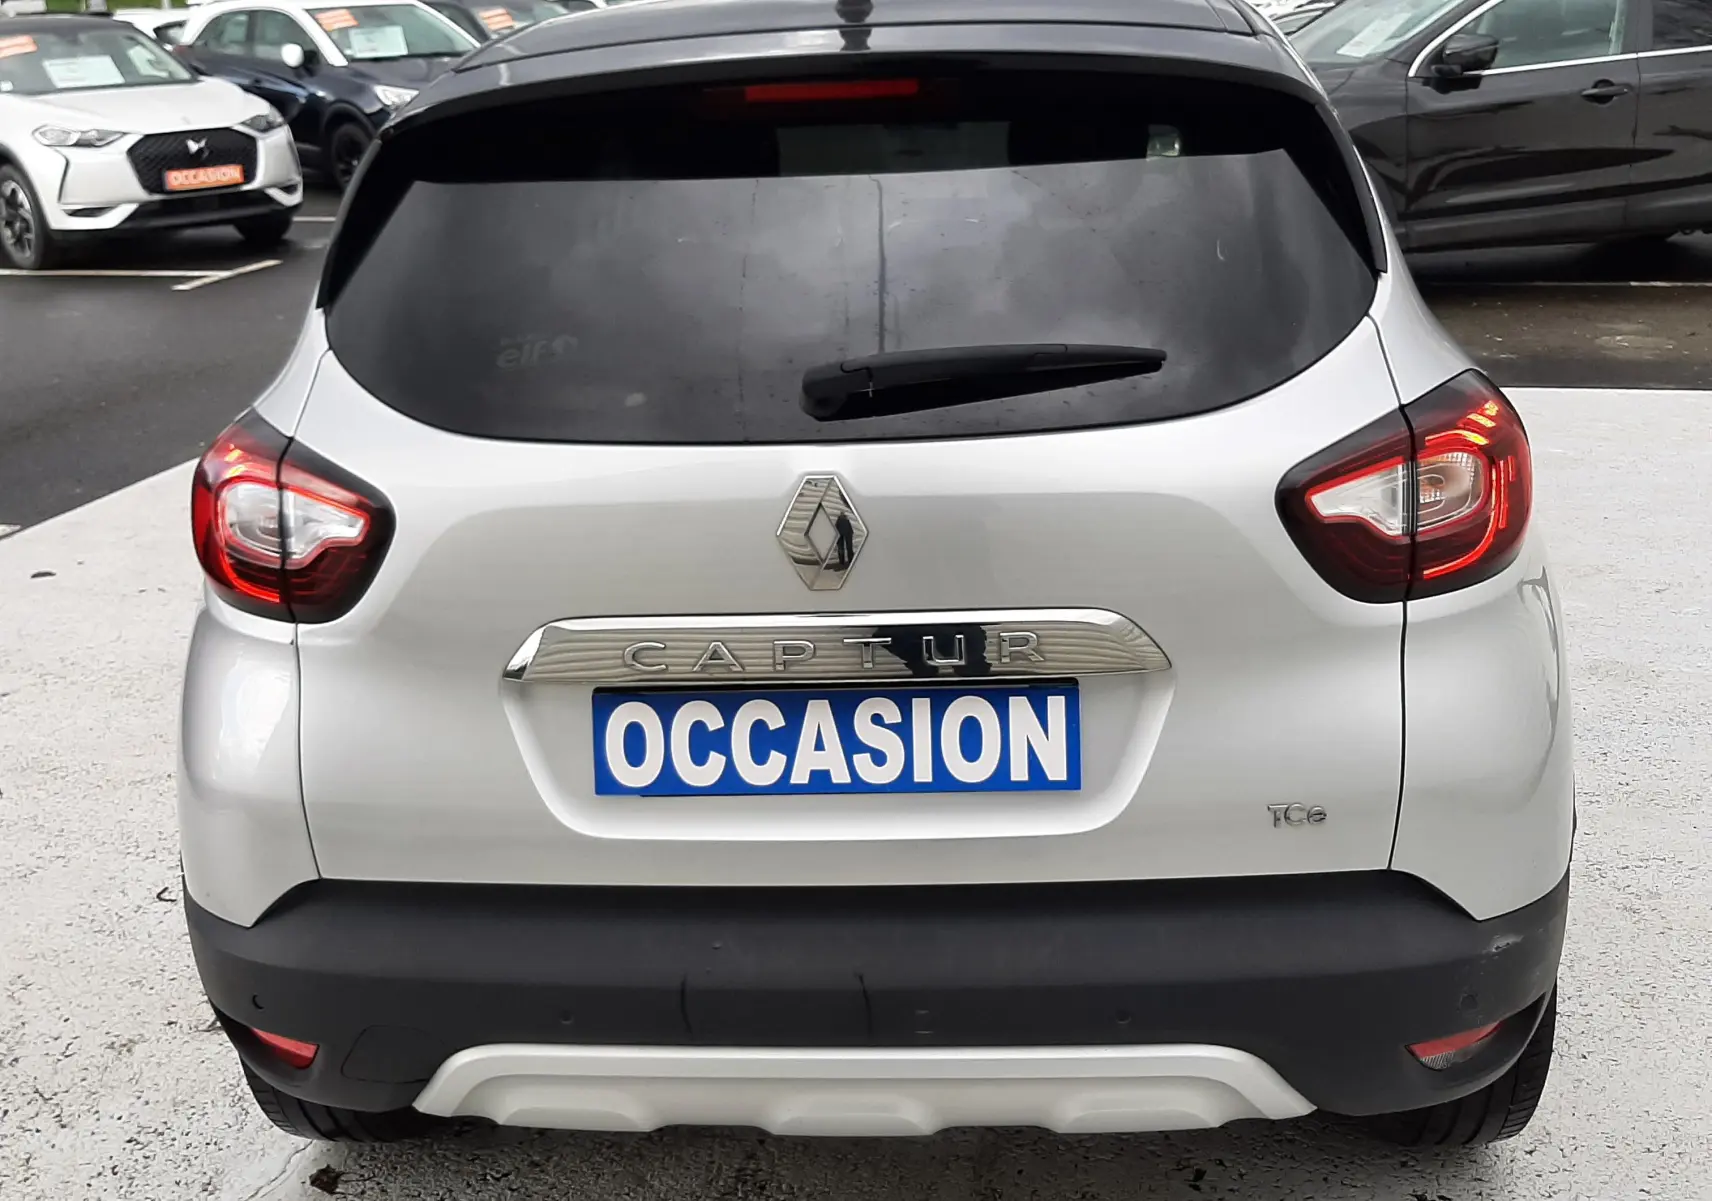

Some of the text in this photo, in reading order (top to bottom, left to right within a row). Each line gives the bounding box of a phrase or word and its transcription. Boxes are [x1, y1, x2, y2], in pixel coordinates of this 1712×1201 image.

[170, 167, 241, 186] OCCASION
[623, 631, 1045, 672] CAPTUR
[605, 694, 1068, 788] OCCASION
[1267, 803, 1327, 828] TCe
